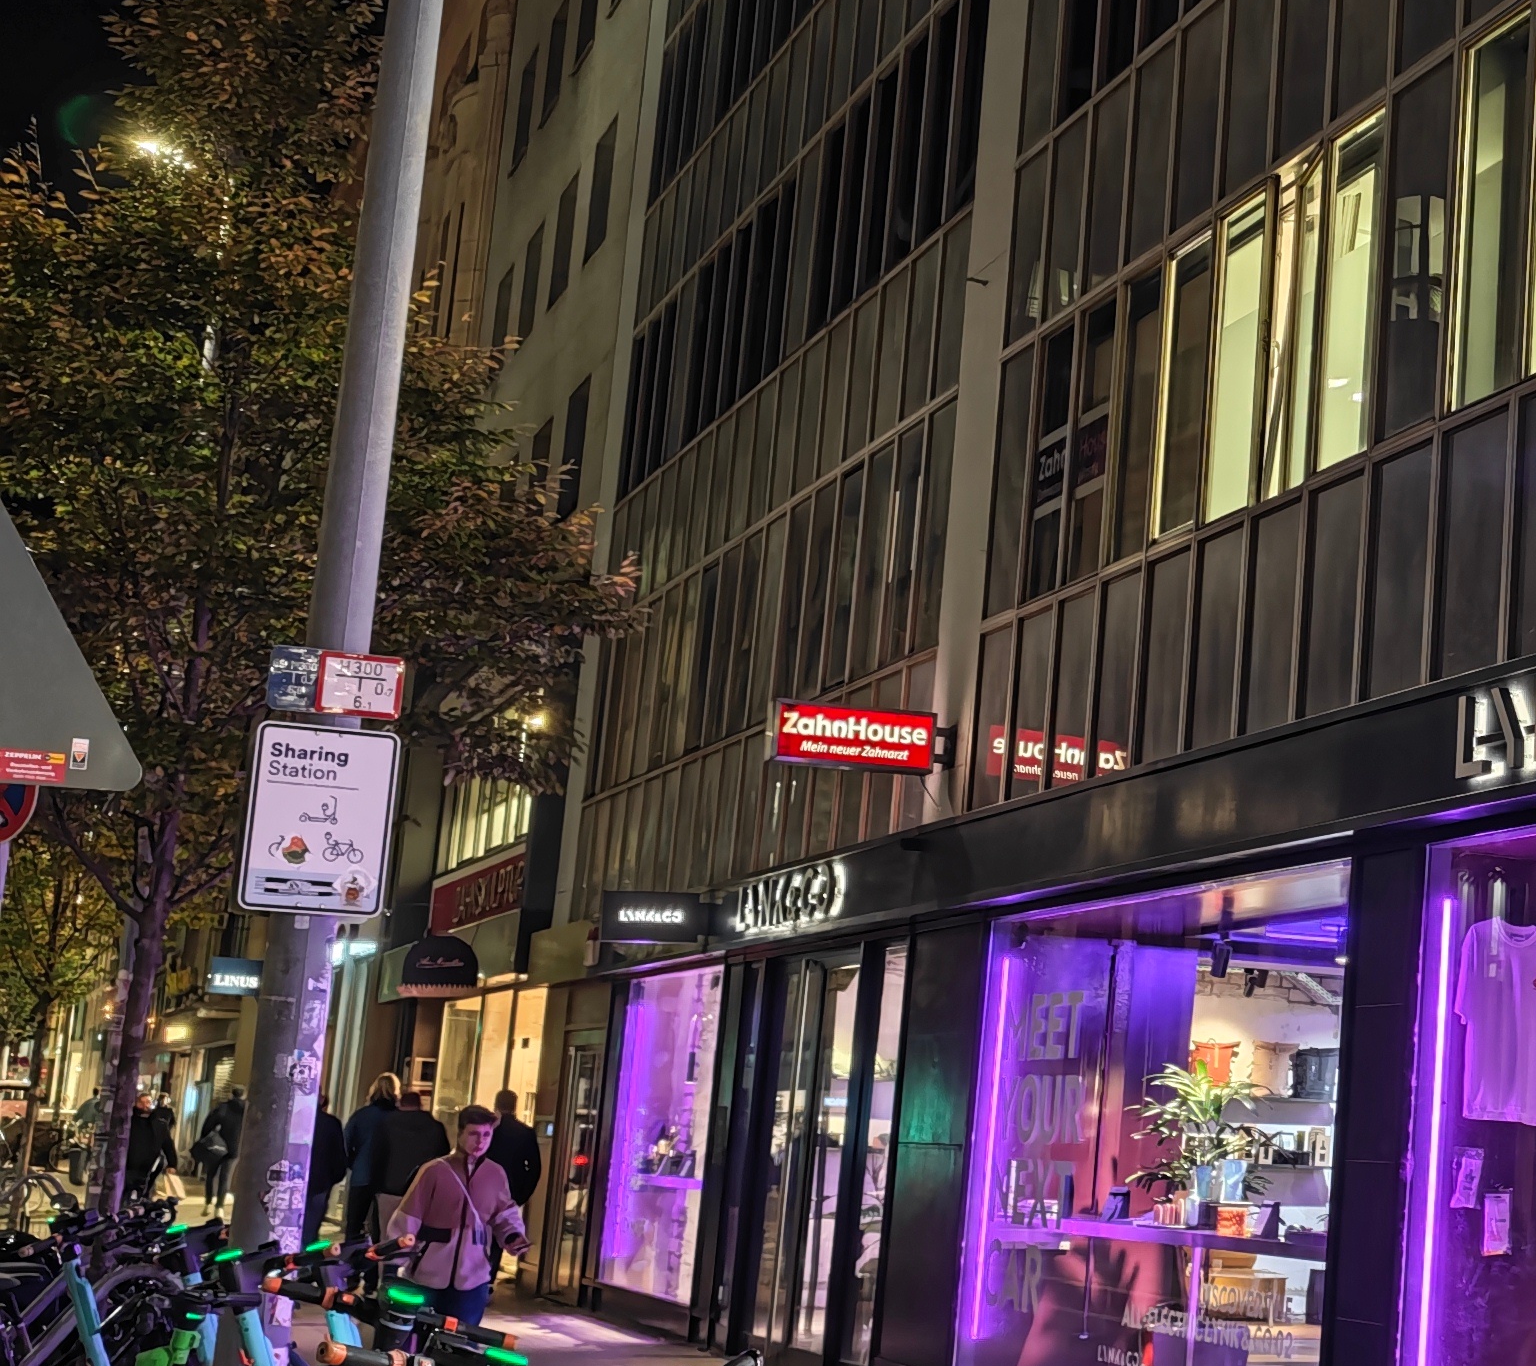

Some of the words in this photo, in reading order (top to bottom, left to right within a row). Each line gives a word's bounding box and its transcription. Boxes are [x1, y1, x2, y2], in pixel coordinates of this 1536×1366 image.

[782, 710, 928, 746] ZahnHouse
[270, 742, 349, 767] Sharing
[799, 740, 828, 753] Mein
[829, 745, 861, 757] neuer
[861, 746, 909, 761] Zahnarzt
[268, 760, 338, 782] Station
[214, 973, 259, 989] LINUS
[1004, 990, 1084, 1062] MEET
[1000, 1073, 1087, 1146] YOUR
